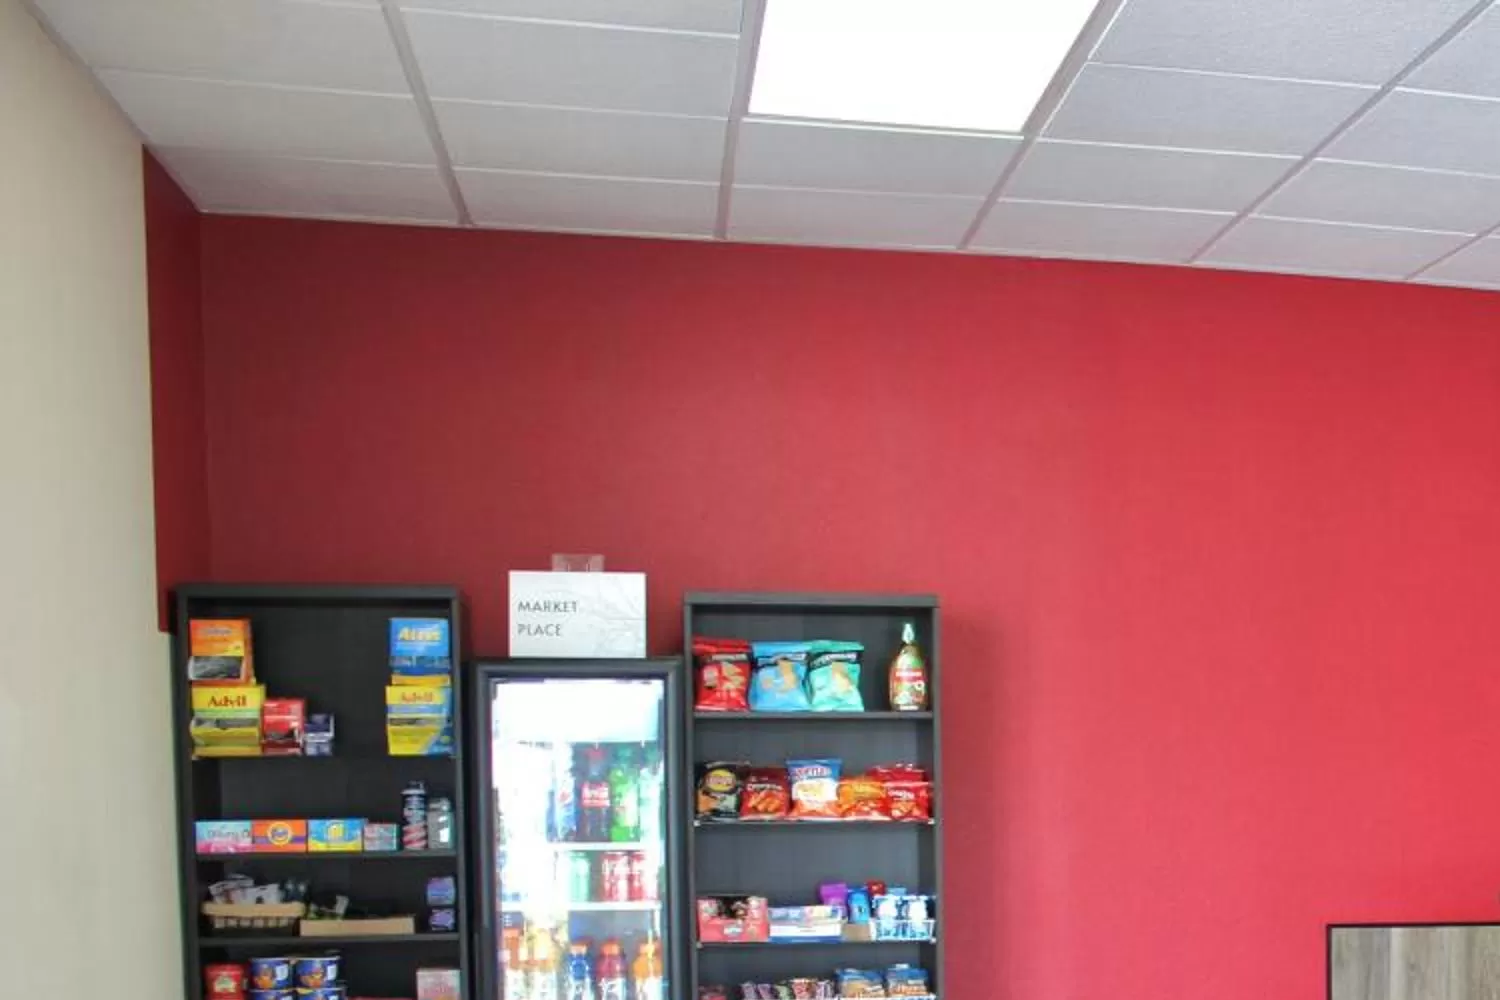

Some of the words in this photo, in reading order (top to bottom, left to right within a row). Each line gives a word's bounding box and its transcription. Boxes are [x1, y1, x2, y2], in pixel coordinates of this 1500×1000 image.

[518, 600, 577, 613] MARKET
[518, 623, 561, 636] PLACE
[207, 695, 247, 708] Advil
